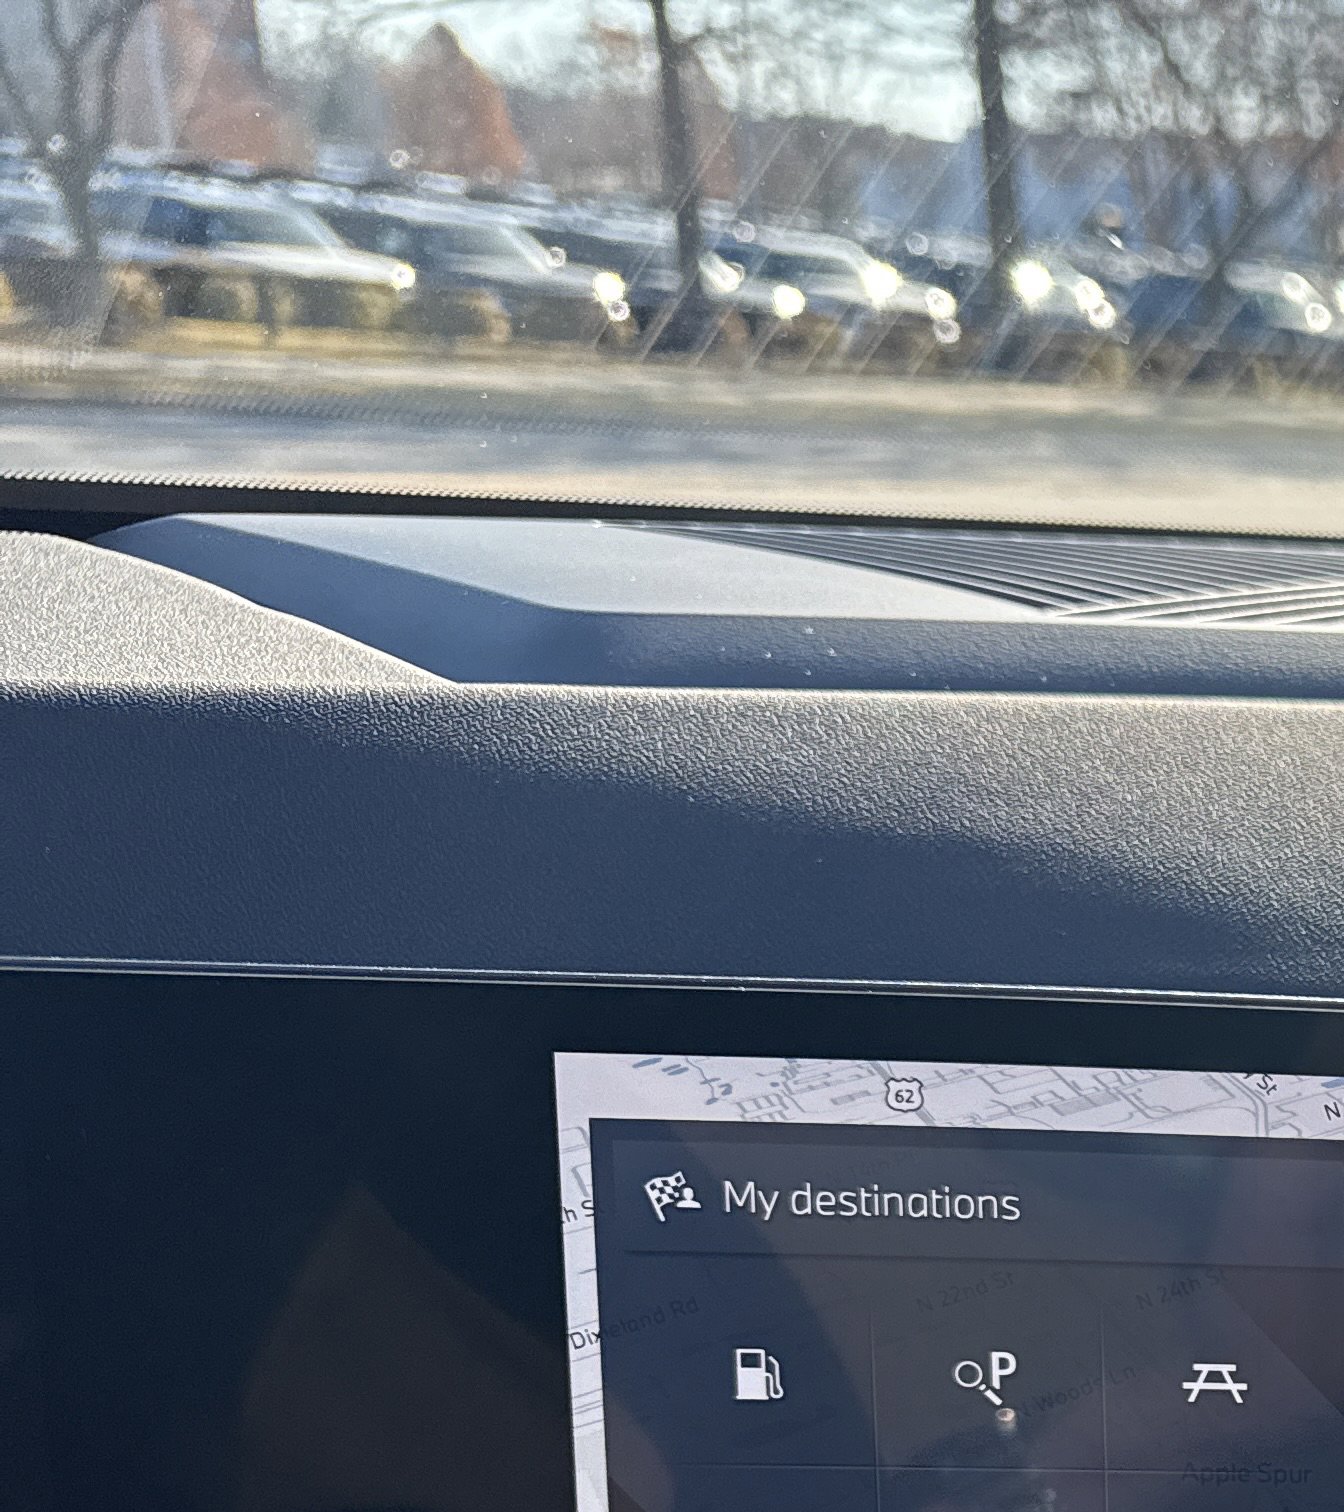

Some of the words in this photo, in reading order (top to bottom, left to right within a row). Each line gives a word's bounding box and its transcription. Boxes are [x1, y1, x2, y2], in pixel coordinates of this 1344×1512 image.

[894, 1089, 914, 1104] 62
[1323, 1101, 1341, 1121] N
[724, 1180, 780, 1221] My
[791, 1182, 1021, 1221] destinations
